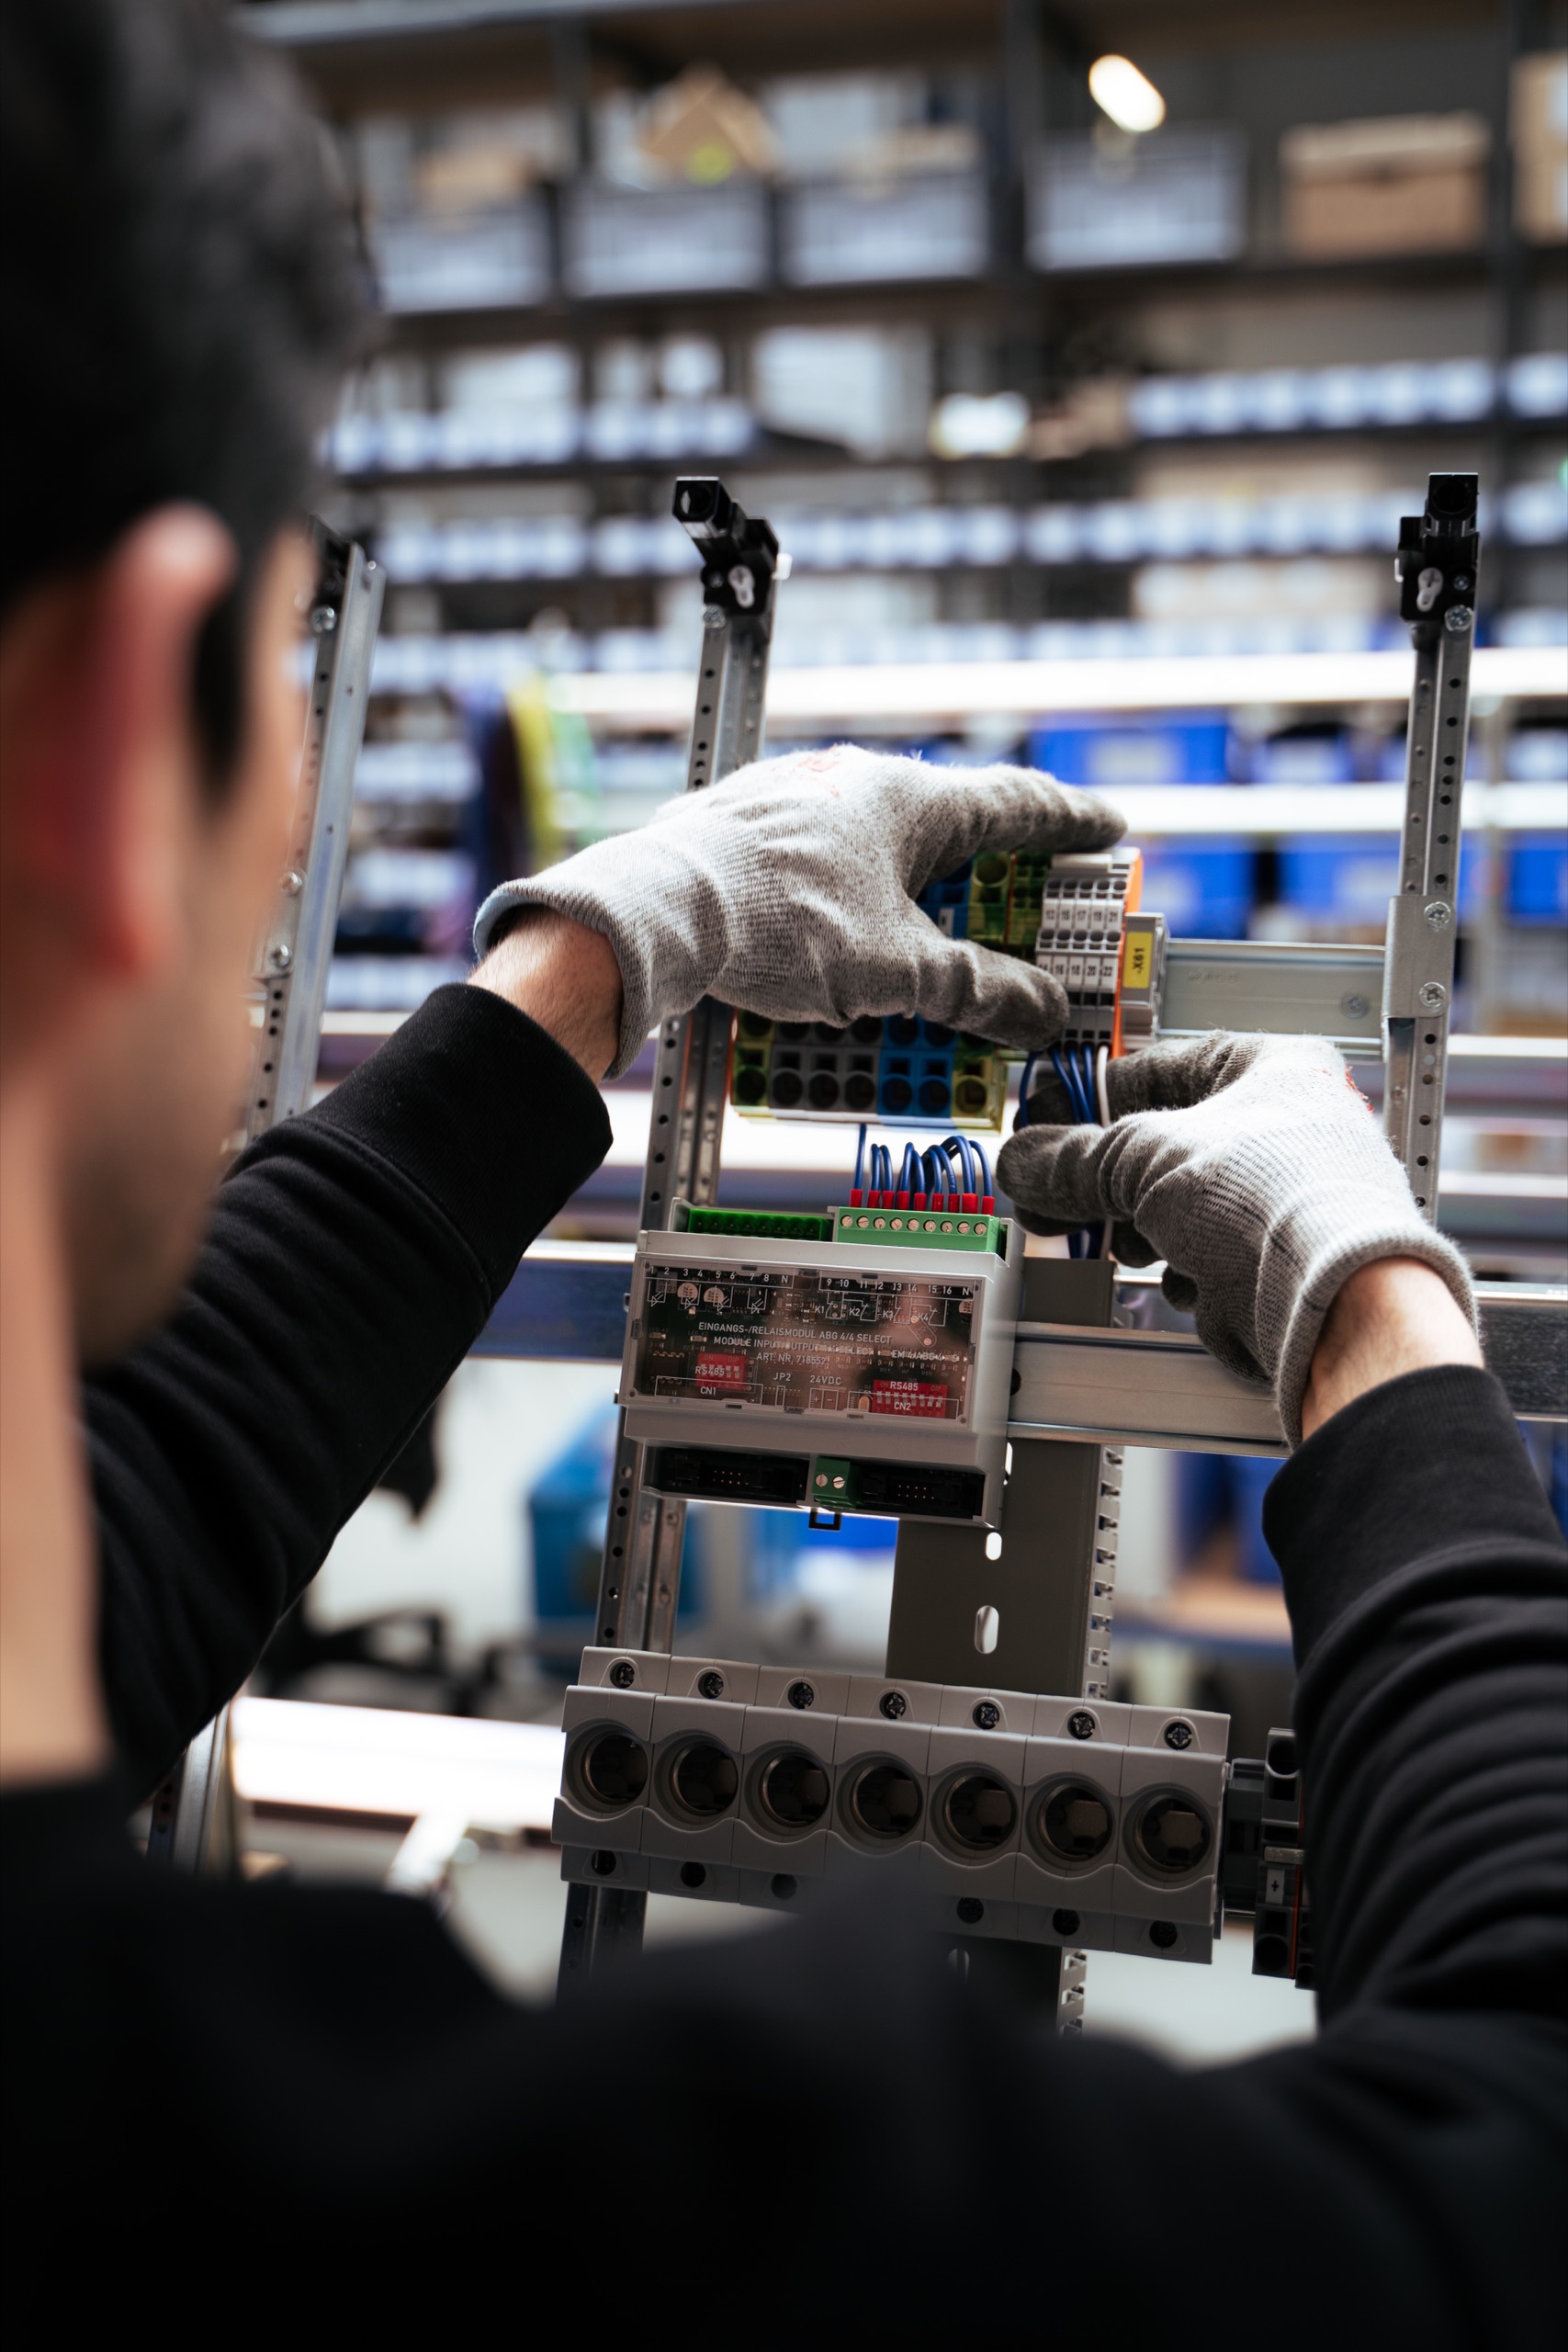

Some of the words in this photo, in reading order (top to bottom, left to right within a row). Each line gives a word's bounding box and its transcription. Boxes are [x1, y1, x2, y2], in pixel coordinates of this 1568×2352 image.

[716, 1271, 721, 1279] 5
[763, 1273, 769, 1282] 8
[782, 1275, 788, 1283] N
[827, 1278, 831, 1286] 9
[840, 1279, 850, 1288] 10
[860, 1281, 868, 1289] 11
[874, 1282, 884, 1290] 12
[893, 1283, 902, 1291] 13
[908, 1284, 917, 1293] 14
[928, 1285, 937, 1294] 15
[942, 1286, 952, 1295] 16
[963, 1287, 970, 1295] N
[815, 1306, 825, 1314] K1
[849, 1307, 860, 1317] K2
[918, 1313, 929, 1321] K4
[698, 1321, 817, 1339] EINGANGS-/RELAISMODUL
[819, 1331, 838, 1340] ABG
[840, 1332, 854, 1341] 4/4
[856, 1333, 892, 1345] SELECT
[714, 1336, 751, 1347] MODULE
[796, 1355, 827, 1364] 718552
[695, 1366, 725, 1376] RS485
[773, 1373, 792, 1382] JP2
[810, 1375, 842, 1385] 24VDC
[700, 1386, 716, 1396] CN1
[889, 1381, 919, 1391] RS485
[894, 1402, 911, 1411] CN2
